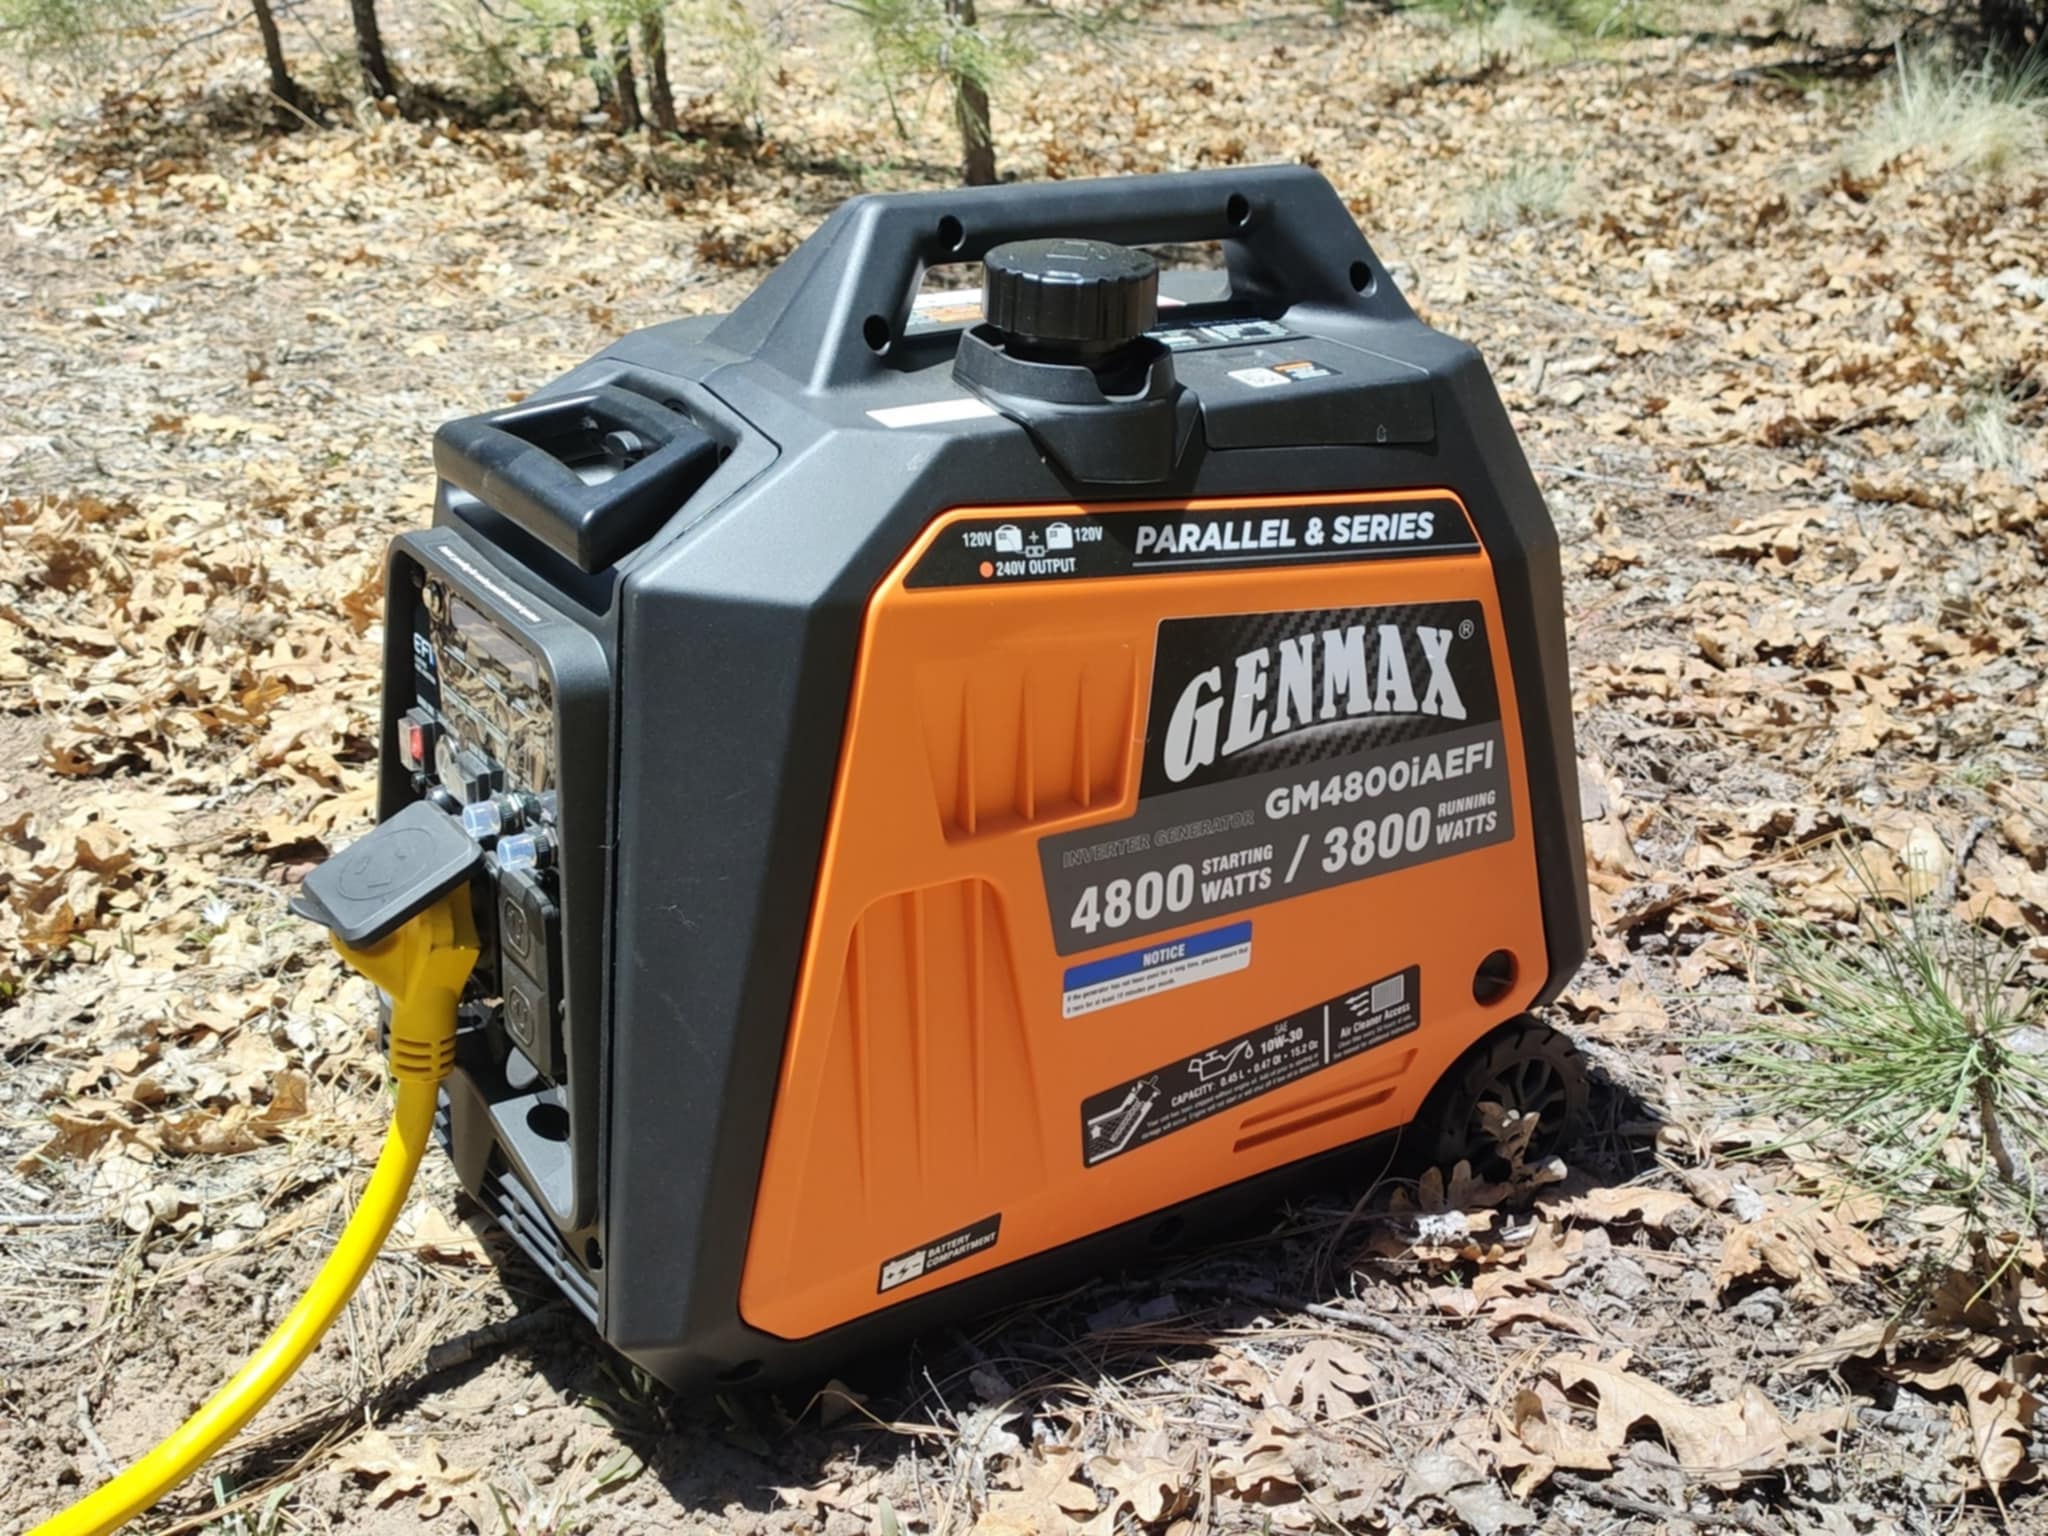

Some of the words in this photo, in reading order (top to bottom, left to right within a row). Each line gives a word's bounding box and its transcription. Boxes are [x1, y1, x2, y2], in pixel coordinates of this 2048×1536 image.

[962, 531, 993, 548] 120V
[1074, 526, 1103, 542] 120V
[1134, 518, 1296, 555] PARALLEL
[1303, 517, 1326, 545] &
[1331, 511, 1435, 544] SERIES
[995, 559, 1026, 577] 240V
[1028, 557, 1076, 574] OUTPUT
[1163, 623, 1468, 784] GENMAX
[1265, 739, 1495, 820] GM4800iAEFI
[1437, 790, 1497, 818] RUNNING
[1063, 833, 1150, 869] INVERTER
[1154, 810, 1255, 847] GENERATOR
[1321, 806, 1431, 873] 3800
[1436, 810, 1498, 845] WATTS
[1202, 844, 1273, 876] STARTING
[1070, 863, 1195, 934] 4800
[1201, 866, 1272, 905] WATTS
[1143, 943, 1186, 967] NOTICE
[1340, 1026, 1352, 1039] Air
[1353, 1014, 1383, 1033] Cleaner
[1384, 1002, 1410, 1020] Access
[1261, 1027, 1303, 1054] 10W-30
[926, 1232, 996, 1268] COMPARTMENT
[927, 1232, 971, 1258] BATTERY
